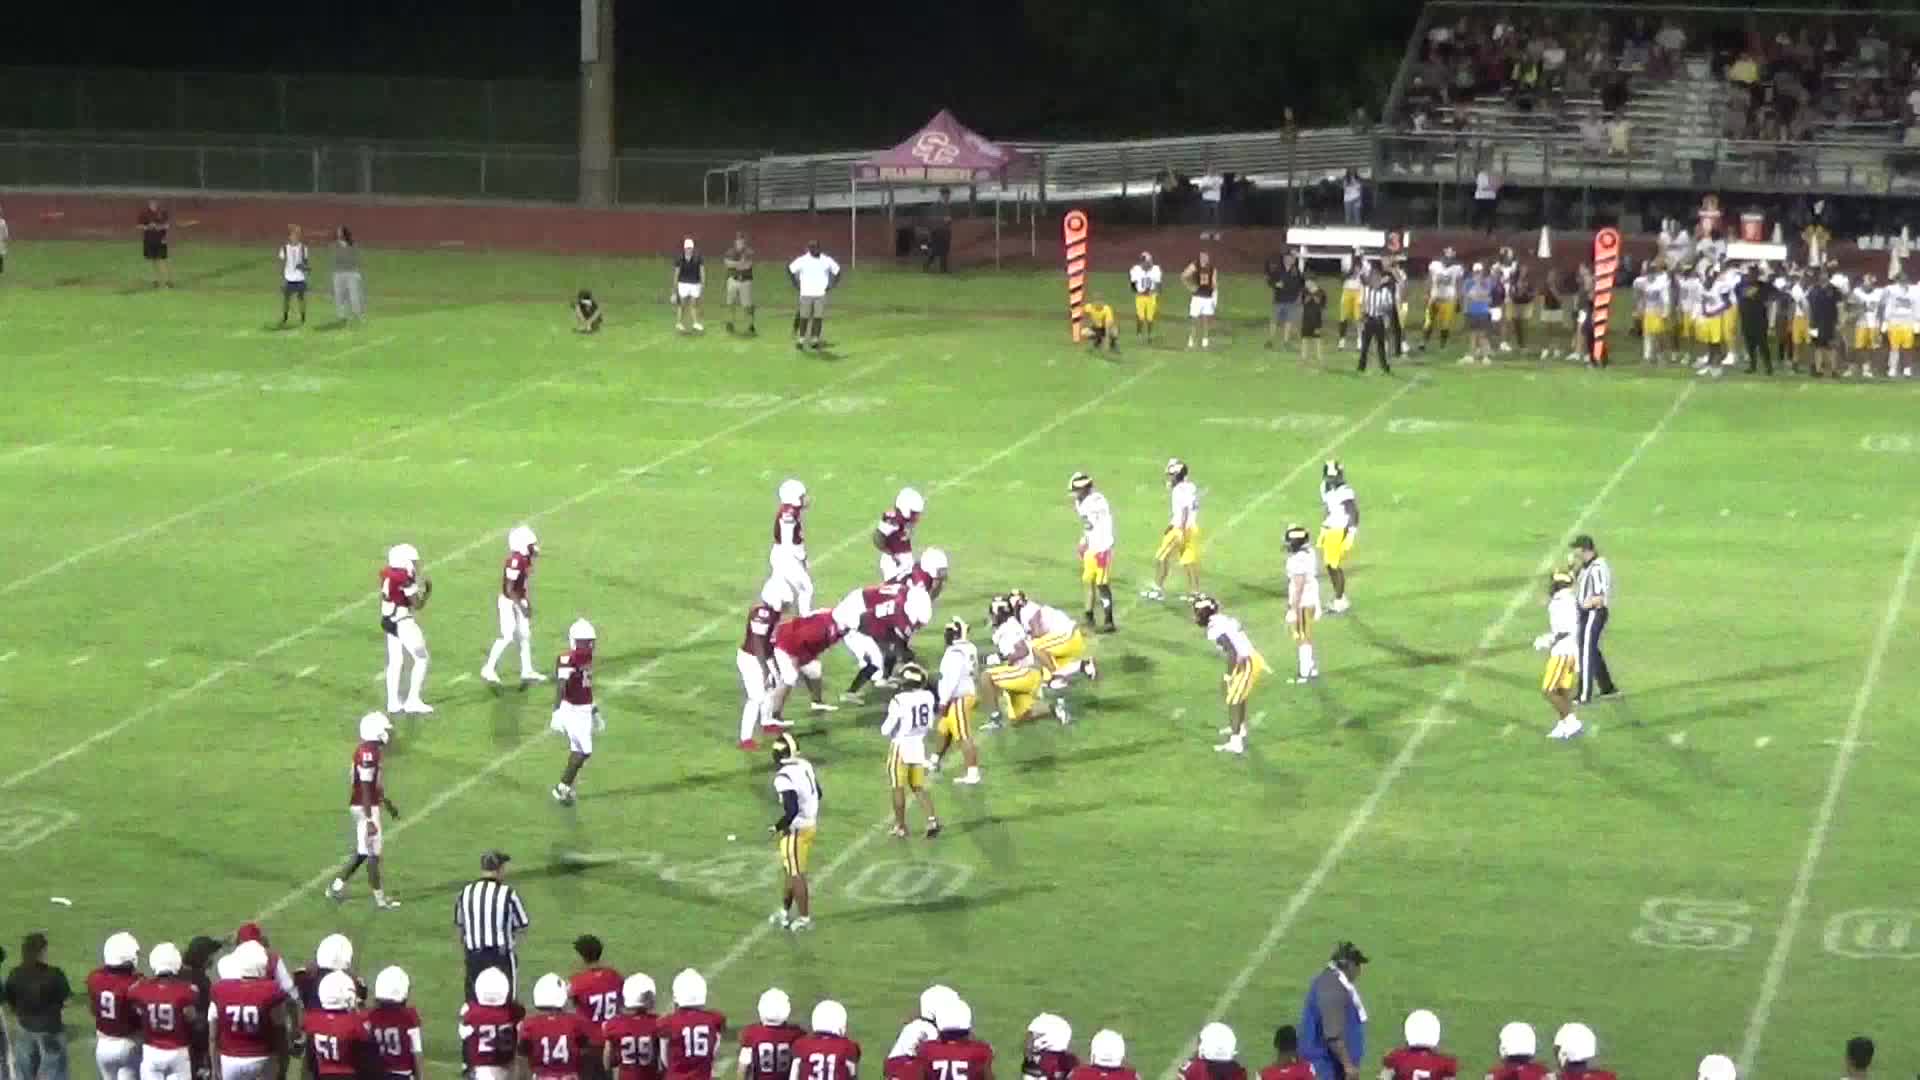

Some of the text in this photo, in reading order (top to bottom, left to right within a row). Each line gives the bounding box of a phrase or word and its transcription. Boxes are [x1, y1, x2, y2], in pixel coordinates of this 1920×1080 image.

[911, 703, 929, 729] 18
[100, 990, 116, 1020] 9
[147, 1003, 174, 1032] 19
[225, 1005, 259, 1033] 70
[589, 991, 617, 1022] 76
[314, 1032, 339, 1060] 51
[478, 1023, 513, 1054] 2
[540, 1034, 569, 1065] 14
[682, 1025, 709, 1057] 16
[807, 1053, 836, 1080] 31
[932, 1060, 969, 1080] 75
